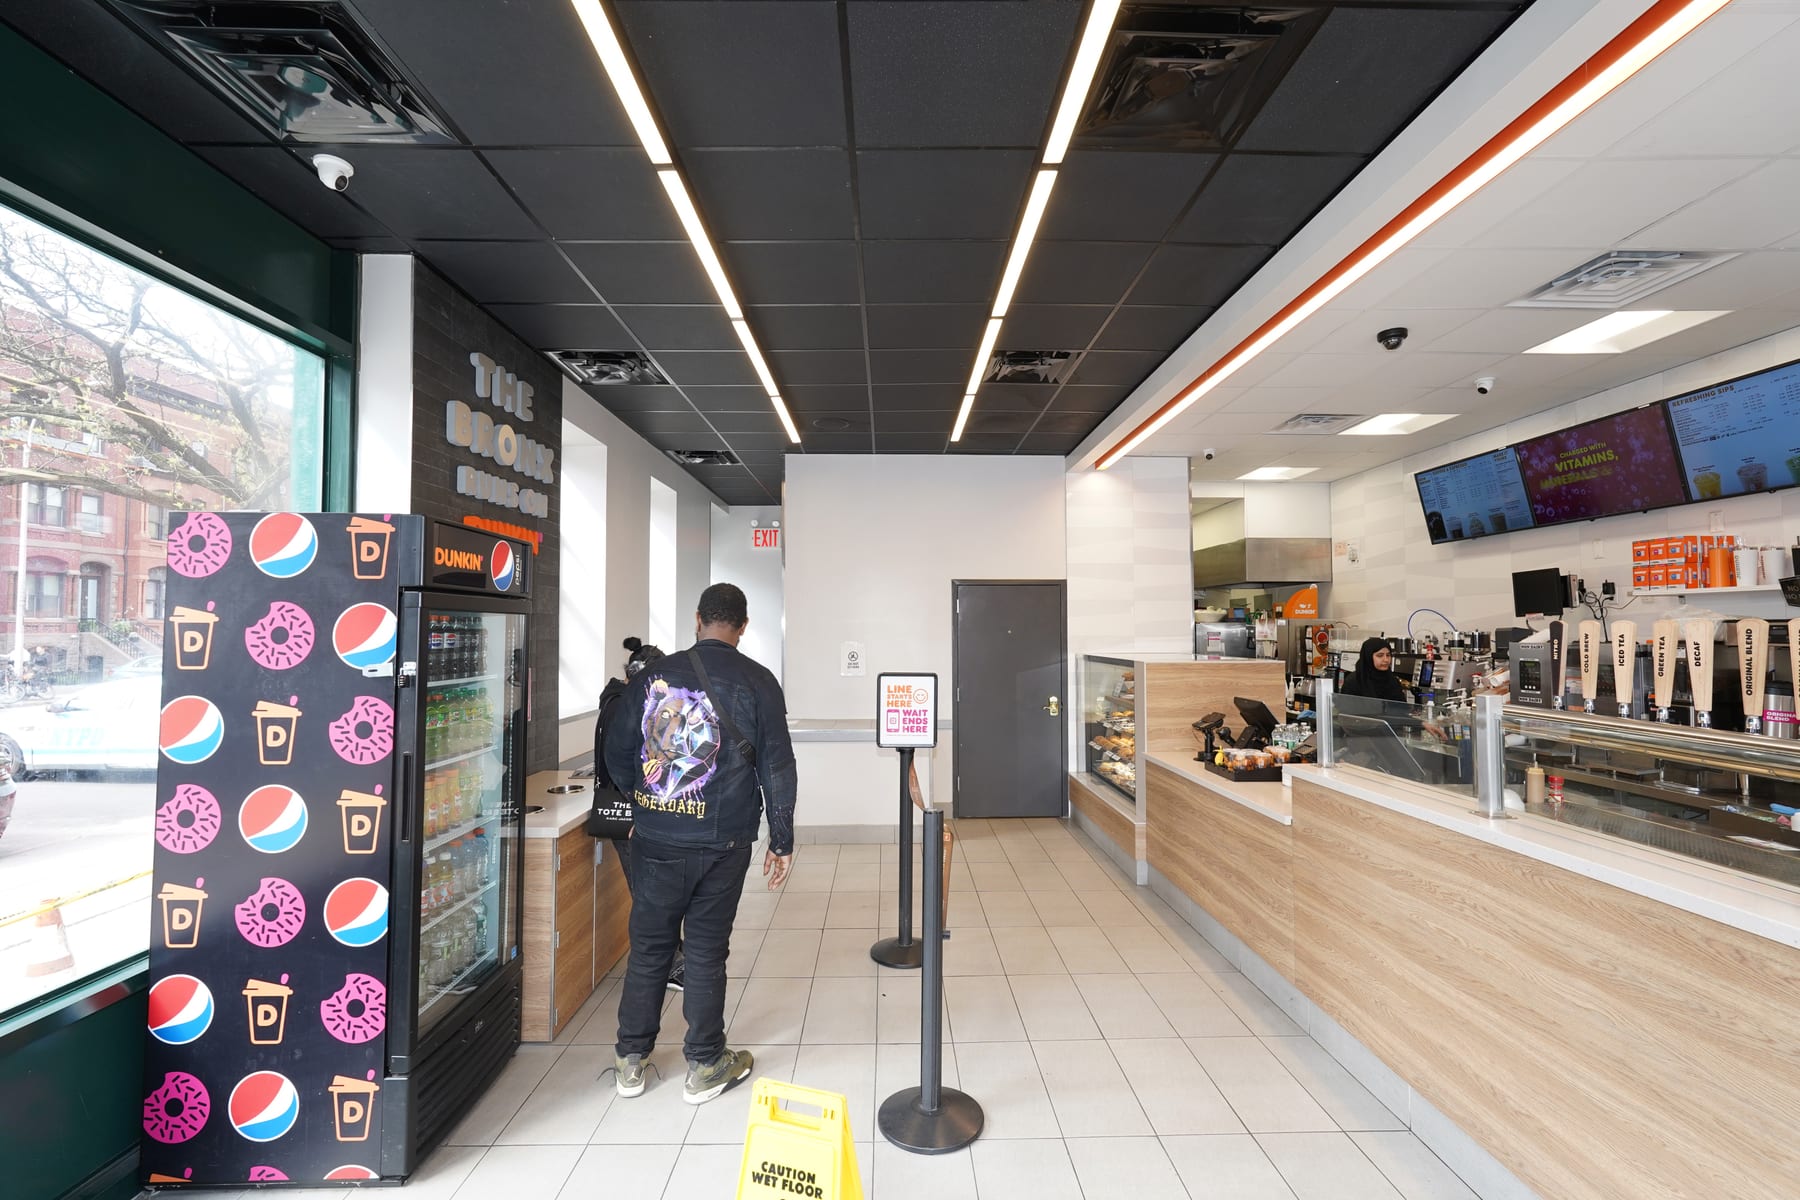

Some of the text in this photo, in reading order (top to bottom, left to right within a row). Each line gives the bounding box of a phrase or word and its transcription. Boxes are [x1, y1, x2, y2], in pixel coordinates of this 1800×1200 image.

[470, 352, 534, 421] THE
[1671, 390, 1717, 408] REFRESHING
[1718, 384, 1735, 395] SIPS
[446, 400, 554, 483] BRONX
[1559, 441, 1607, 459] CHARGED WITH
[1554, 449, 1619, 472] VITAMINS,
[457, 465, 548, 518] RUNS ON
[753, 529, 779, 547] EXIT
[361, 541, 380, 562] D
[434, 547, 484, 571] DUNKIN'
[184, 631, 203, 653] D
[1693, 641, 1701, 667] DECAF
[887, 685, 912, 693] LINE
[902, 709, 928, 717] WAIT
[902, 717, 928, 725] ENDS
[1766, 711, 1797, 719] ORIGINA
[266, 725, 286, 748] D
[597, 808, 624, 817] TOTE
[613, 801, 633, 809] THE
[634, 790, 706, 818] LEGENDARY
[352, 816, 370, 835] D
[174, 910, 191, 928] D
[257, 1004, 277, 1026] D
[344, 1101, 363, 1122] D
[761, 1161, 816, 1185] CAUTION
[752, 1171, 823, 1200] WET FLOOR
